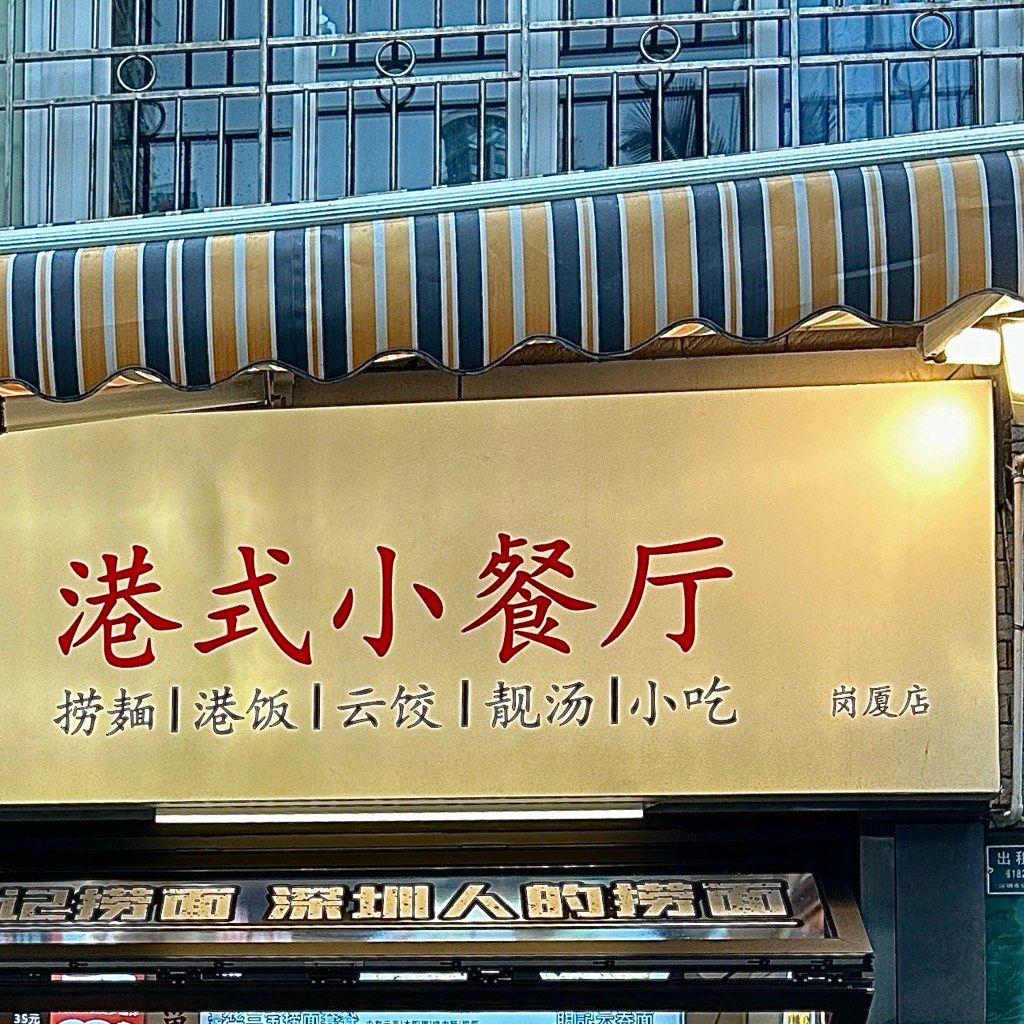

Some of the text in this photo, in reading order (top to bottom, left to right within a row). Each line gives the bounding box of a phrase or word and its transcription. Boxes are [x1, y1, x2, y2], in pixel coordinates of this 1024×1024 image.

[58, 533, 734, 668] 港式小餐厅
[193, 688, 298, 735] 港饭
[336, 684, 443, 730] 云饺
[485, 681, 592, 727] 靓汤
[630, 676, 737, 726] 小吃
[831, 684, 931, 718] 岗厦店
[268, 881, 791, 921] 深圳人的捞面
[13, 1013, 41, 1024] 35元
